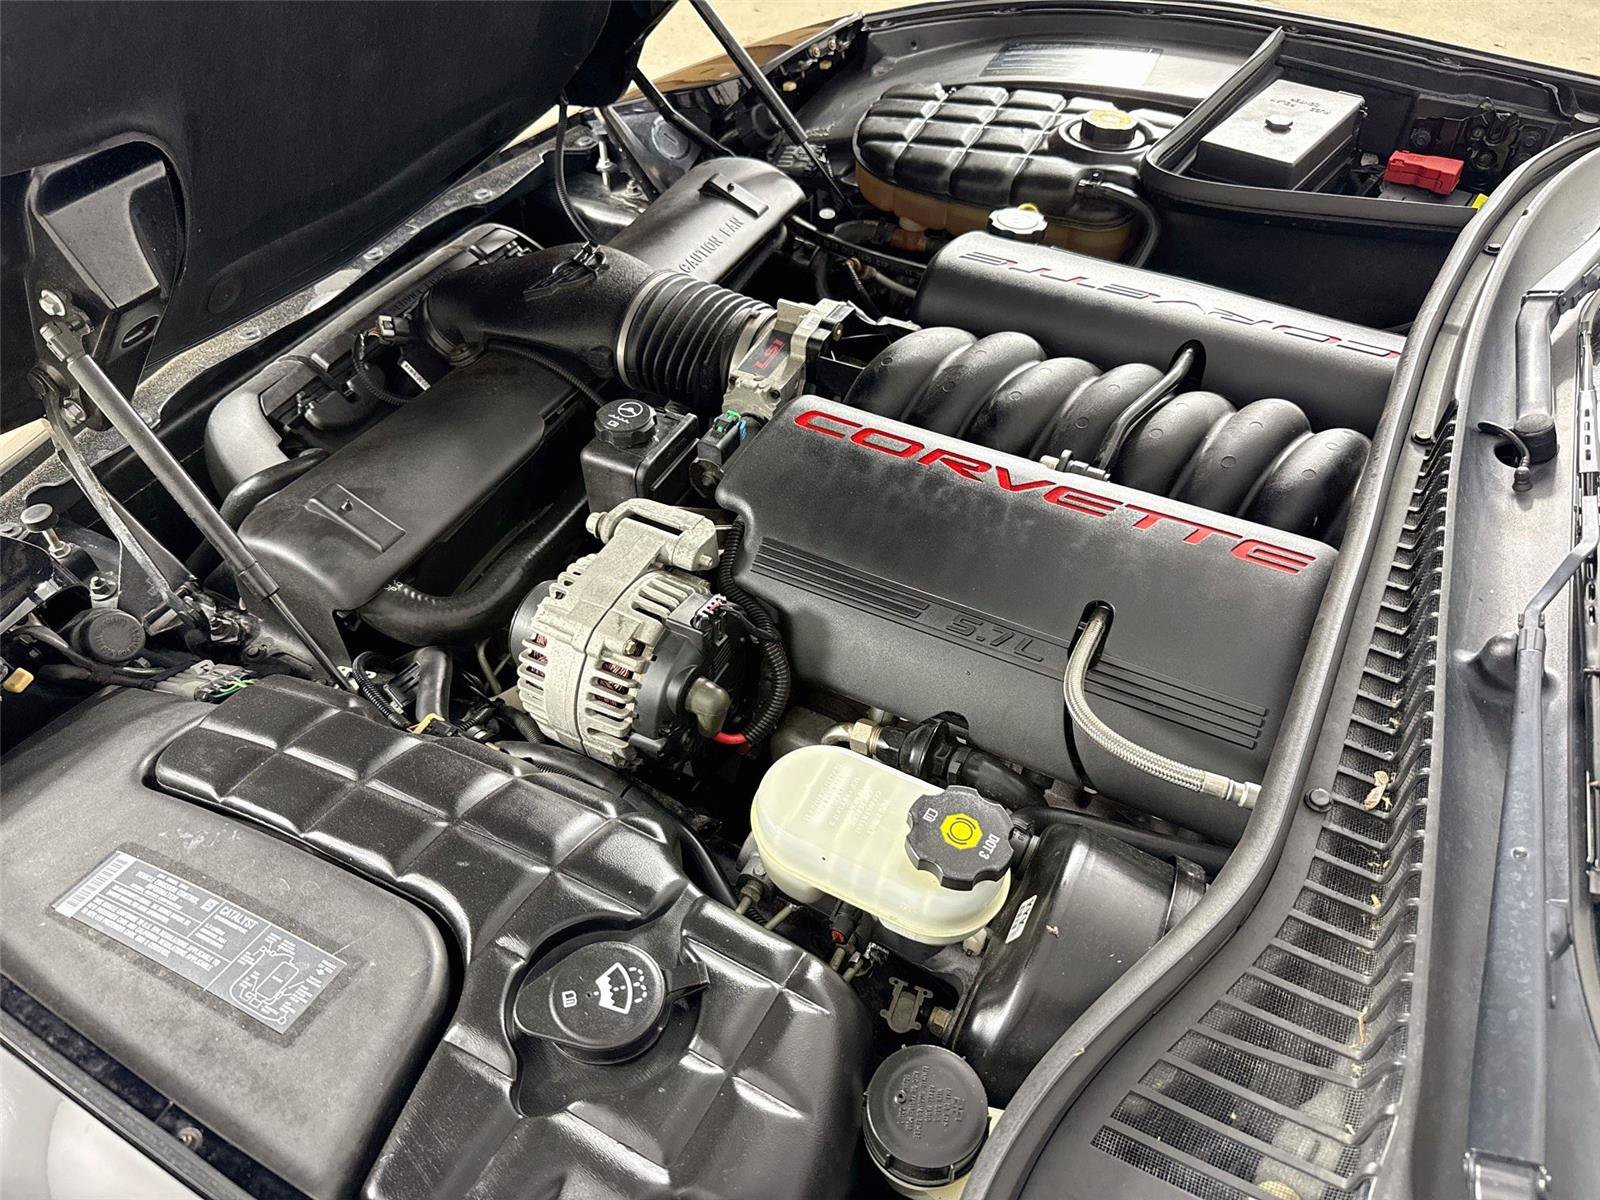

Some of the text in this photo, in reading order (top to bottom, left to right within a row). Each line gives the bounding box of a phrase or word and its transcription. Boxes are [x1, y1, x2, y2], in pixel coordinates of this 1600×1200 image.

[679, 216, 744, 273] CAUTION FAN
[793, 409, 1317, 575] CORVETTE
[945, 614, 1045, 663] 5.7L
[978, 833, 1001, 860] DOT 3
[219, 906, 259, 930] CATALYST
